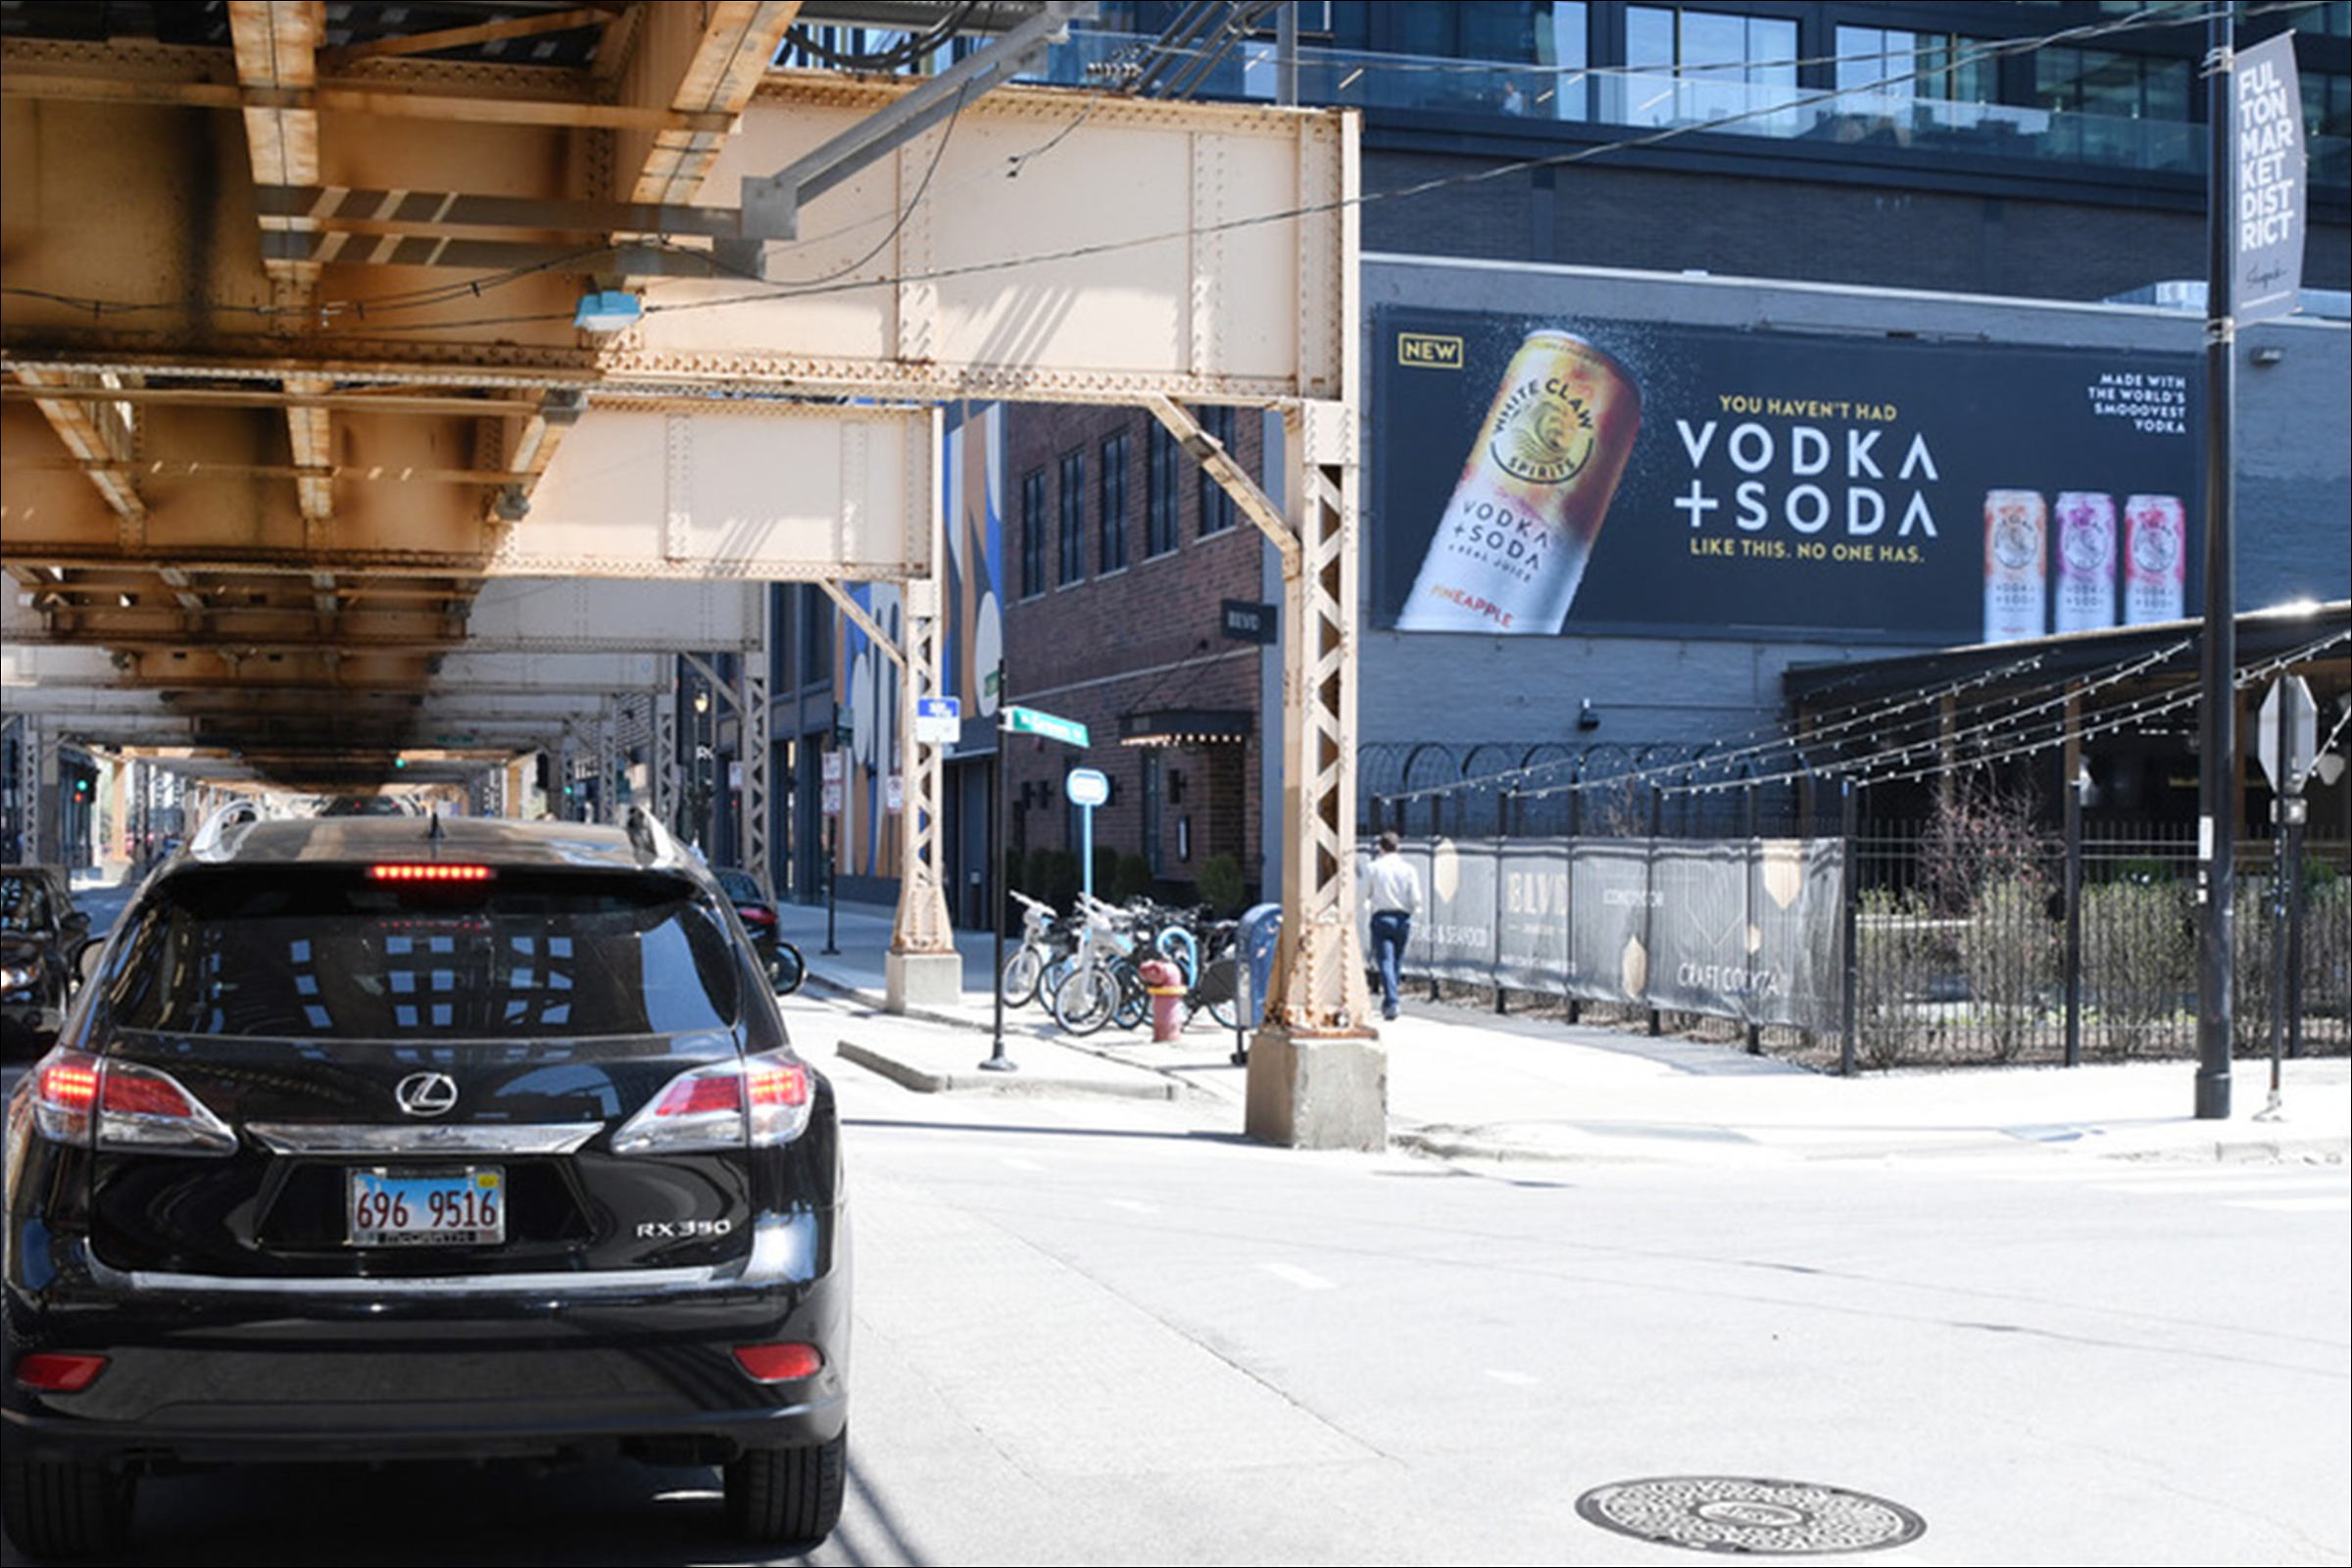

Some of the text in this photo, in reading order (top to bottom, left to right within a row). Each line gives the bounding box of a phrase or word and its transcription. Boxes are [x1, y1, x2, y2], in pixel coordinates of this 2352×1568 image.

[2238, 61, 2281, 101] FUL
[2239, 89, 2287, 128] TON
[2240, 118, 2294, 161] MAR
[2241, 151, 2286, 191] KET
[2241, 179, 2294, 221] DIST
[2241, 210, 2294, 252] RICT
[1405, 341, 1456, 361] NEW
[2087, 387, 2185, 404] THE WORLD'S
[2100, 373, 2185, 389] MADE WITH
[1493, 377, 1593, 435] WHITE CLAW
[1719, 394, 1897, 421] YOU HAVEN'T HAD
[2094, 402, 2185, 417] SMOOOVEST
[2133, 418, 2186, 433] VODKA
[1676, 419, 1939, 480] VODKA
[1464, 501, 1547, 549] VODKA
[1690, 537, 1925, 564] LIKE THIS. NO ONE HAS.
[357, 1190, 497, 1228] 696 9516
[637, 1221, 674, 1237] RX
